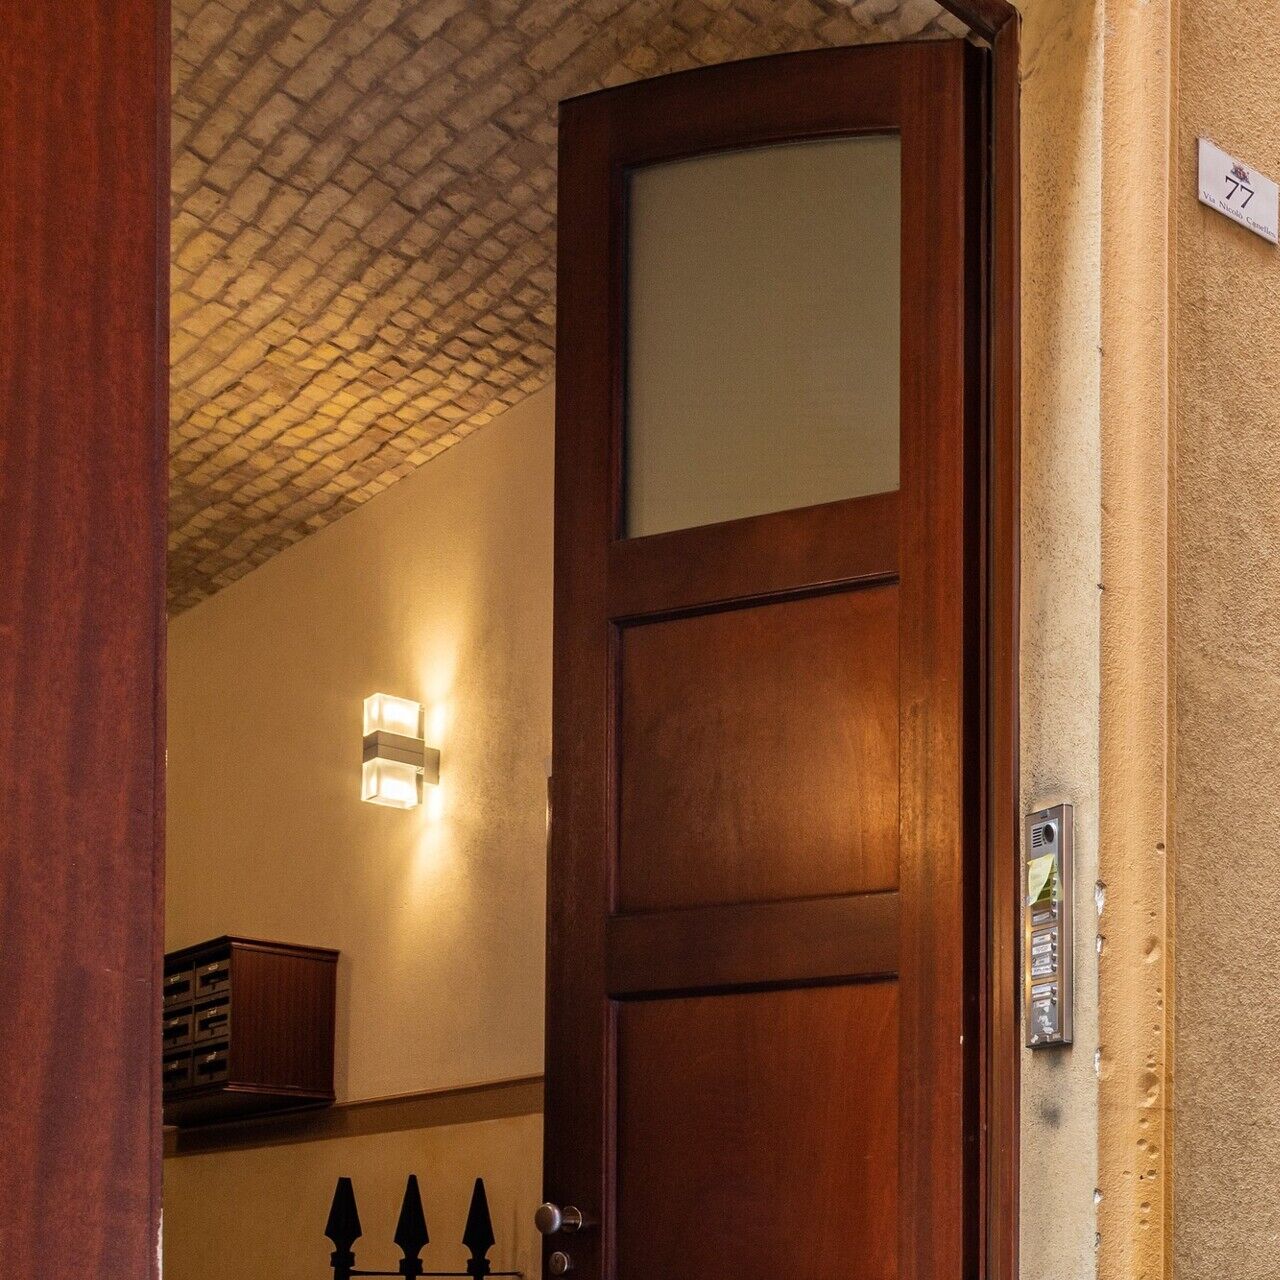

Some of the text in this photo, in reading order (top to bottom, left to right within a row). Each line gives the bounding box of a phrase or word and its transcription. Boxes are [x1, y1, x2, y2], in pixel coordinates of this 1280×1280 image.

[1225, 175, 1255, 209] 77
[1203, 191, 1216, 203] Via
[1246, 216, 1276, 239] Canelles
